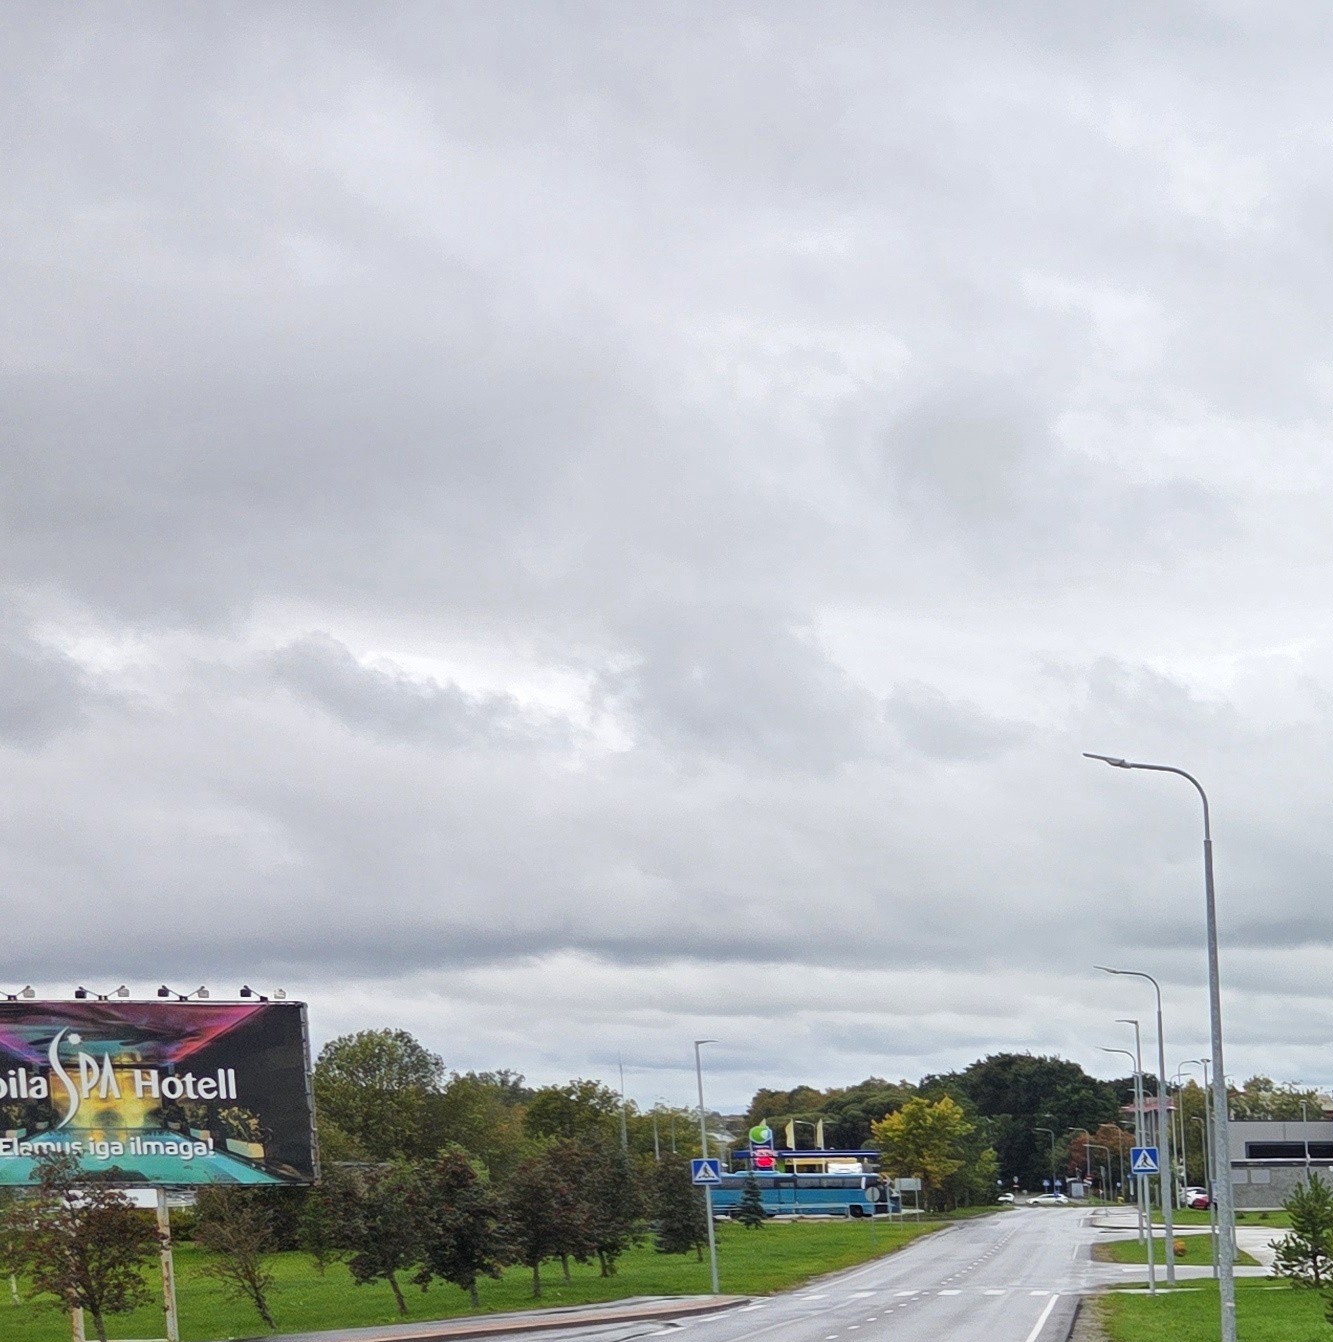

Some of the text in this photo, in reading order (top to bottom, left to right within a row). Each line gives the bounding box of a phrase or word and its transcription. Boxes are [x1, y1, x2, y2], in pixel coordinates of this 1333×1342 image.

[48, 1026, 121, 1129] SPA
[133, 1068, 238, 1100] Hotell
[0, 1136, 215, 1160] Elamus iga ilmaga!
